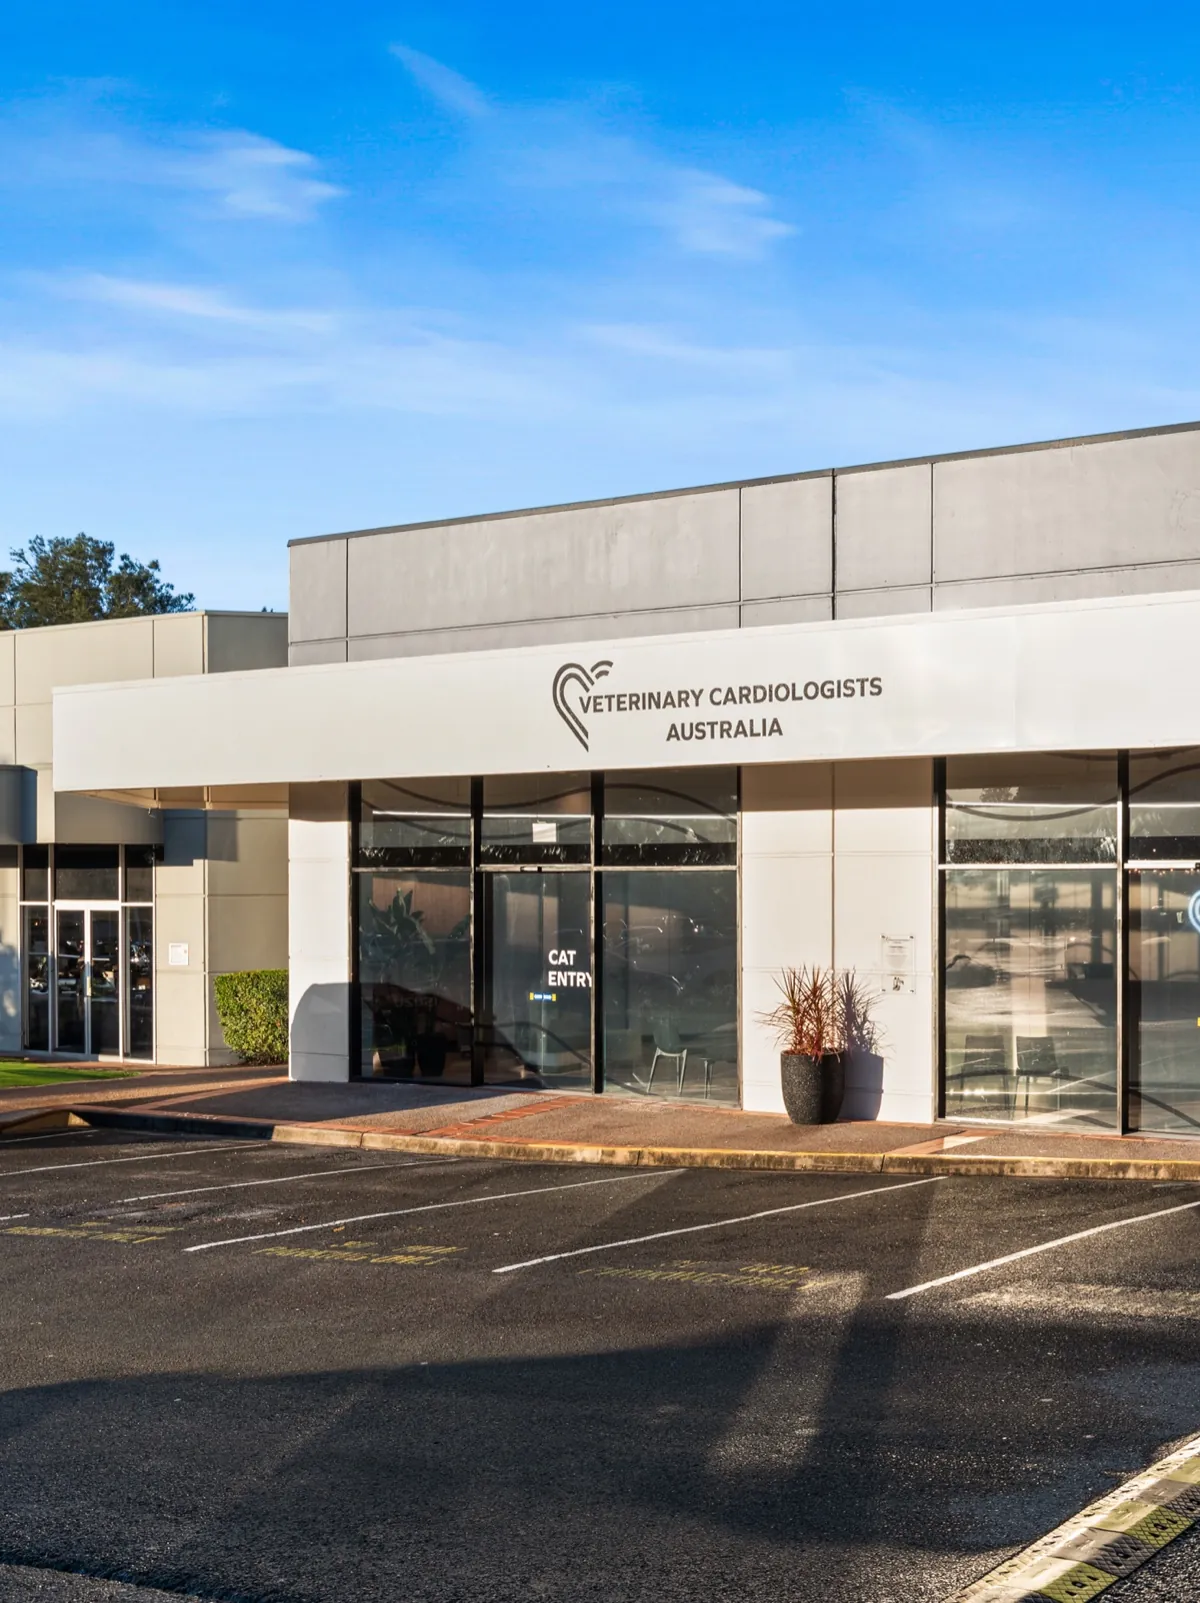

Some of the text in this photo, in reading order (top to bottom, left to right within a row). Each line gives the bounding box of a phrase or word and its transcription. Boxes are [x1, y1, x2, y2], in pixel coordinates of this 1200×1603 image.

[578, 677, 883, 714] VETERINARY CARDIOLOGISTS
[666, 717, 784, 742] AUSTRALIA
[548, 949, 577, 966] CAT
[548, 970, 592, 988] ENTRY
